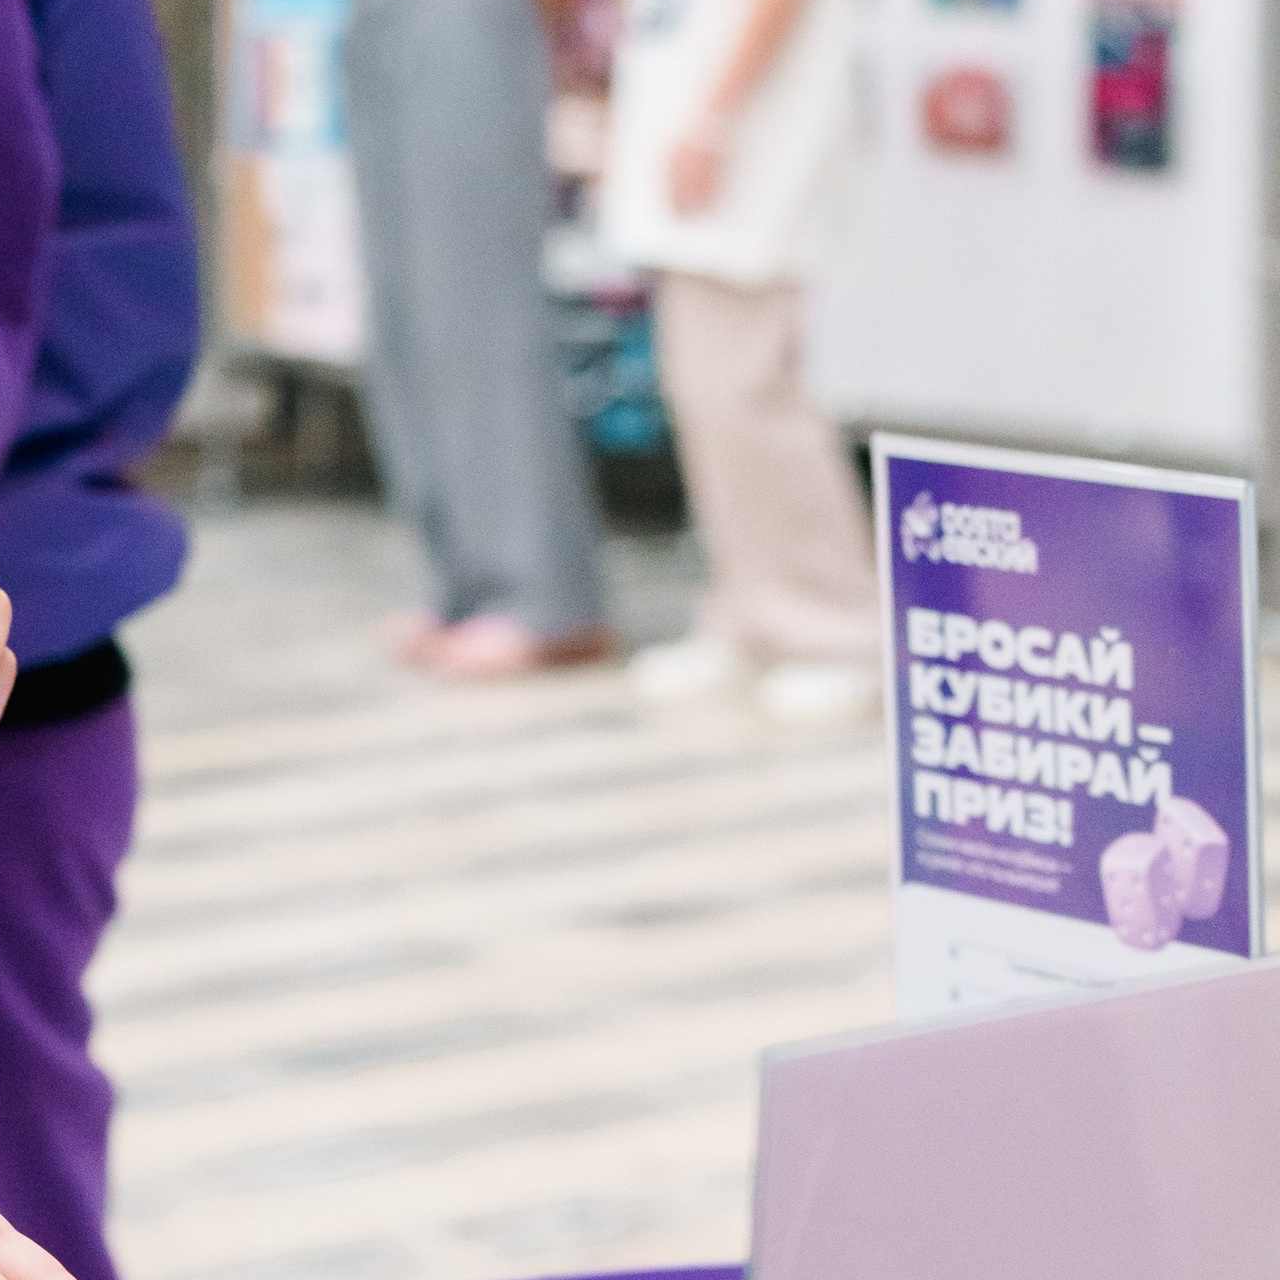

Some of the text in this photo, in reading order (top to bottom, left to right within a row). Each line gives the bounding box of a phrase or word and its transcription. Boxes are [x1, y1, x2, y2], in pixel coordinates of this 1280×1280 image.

[906, 606, 1134, 691] БРОСАЙ
[911, 714, 1173, 809] ЗАБИРАЙ
[913, 771, 1074, 848] ПРИЗ!
